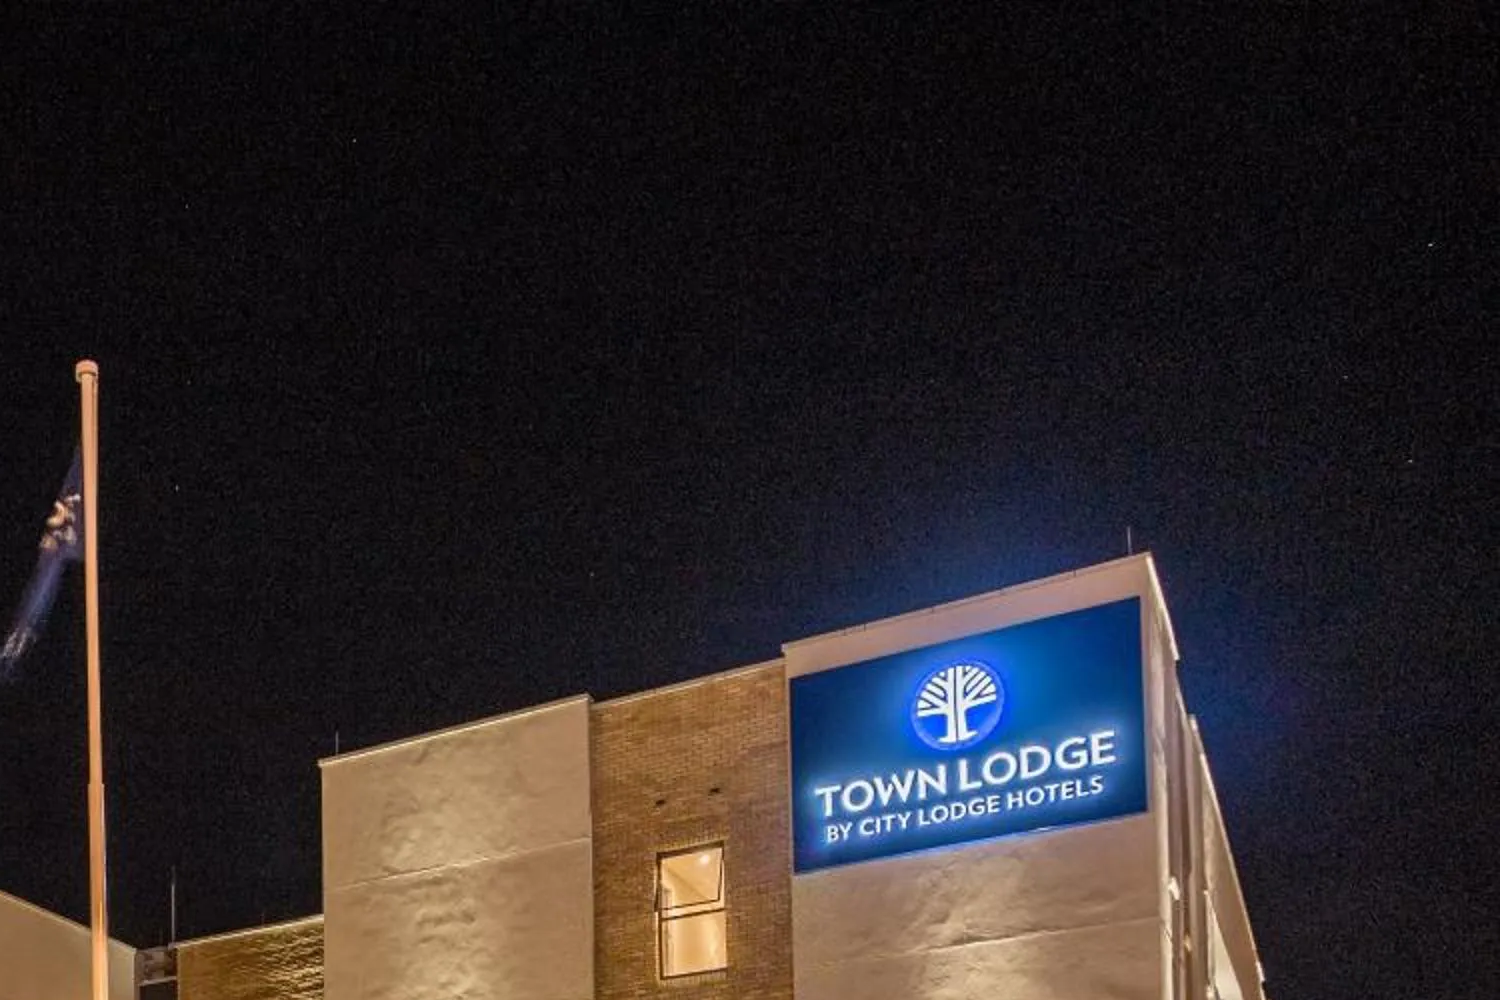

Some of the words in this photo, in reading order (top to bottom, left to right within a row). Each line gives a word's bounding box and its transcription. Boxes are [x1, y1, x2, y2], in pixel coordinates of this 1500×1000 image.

[813, 764, 948, 818] TOWN
[957, 729, 1118, 793] LODGE
[826, 821, 853, 844] BY
[858, 810, 912, 837] CITY
[917, 794, 1001, 828] LODGE
[1006, 774, 1104, 810] HOTELS
